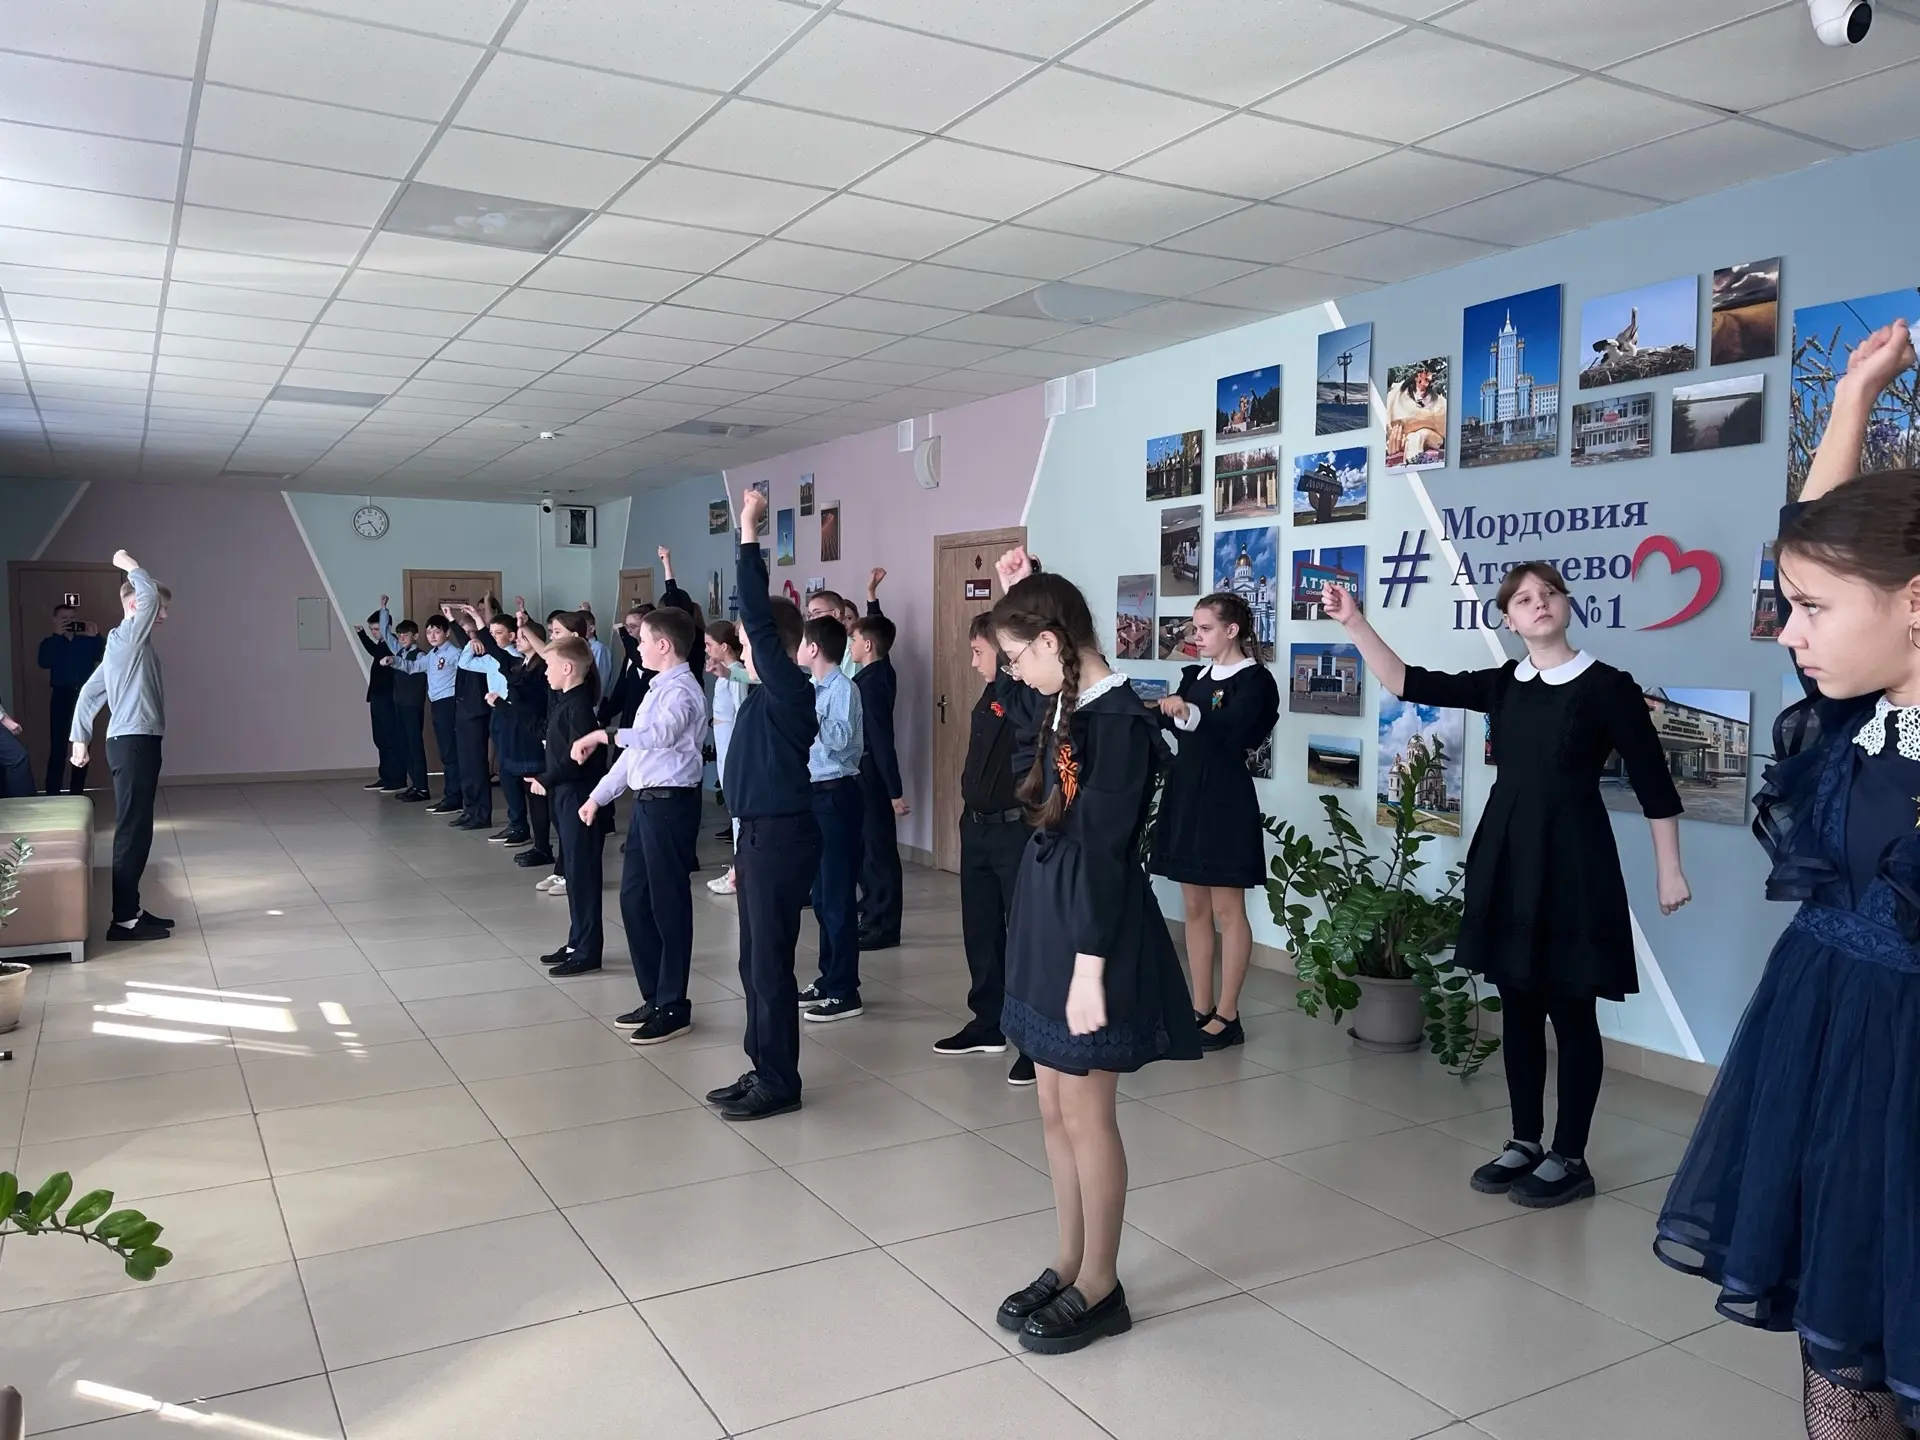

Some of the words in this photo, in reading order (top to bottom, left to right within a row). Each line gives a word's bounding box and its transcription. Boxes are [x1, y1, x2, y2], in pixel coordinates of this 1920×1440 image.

[1441, 500, 1649, 546] Мордовия
[1300, 576, 1358, 593] АТЯВО
[1379, 529, 1431, 608] #
[1450, 551, 1632, 586] Атяево
[1453, 598, 1515, 630] ПС
